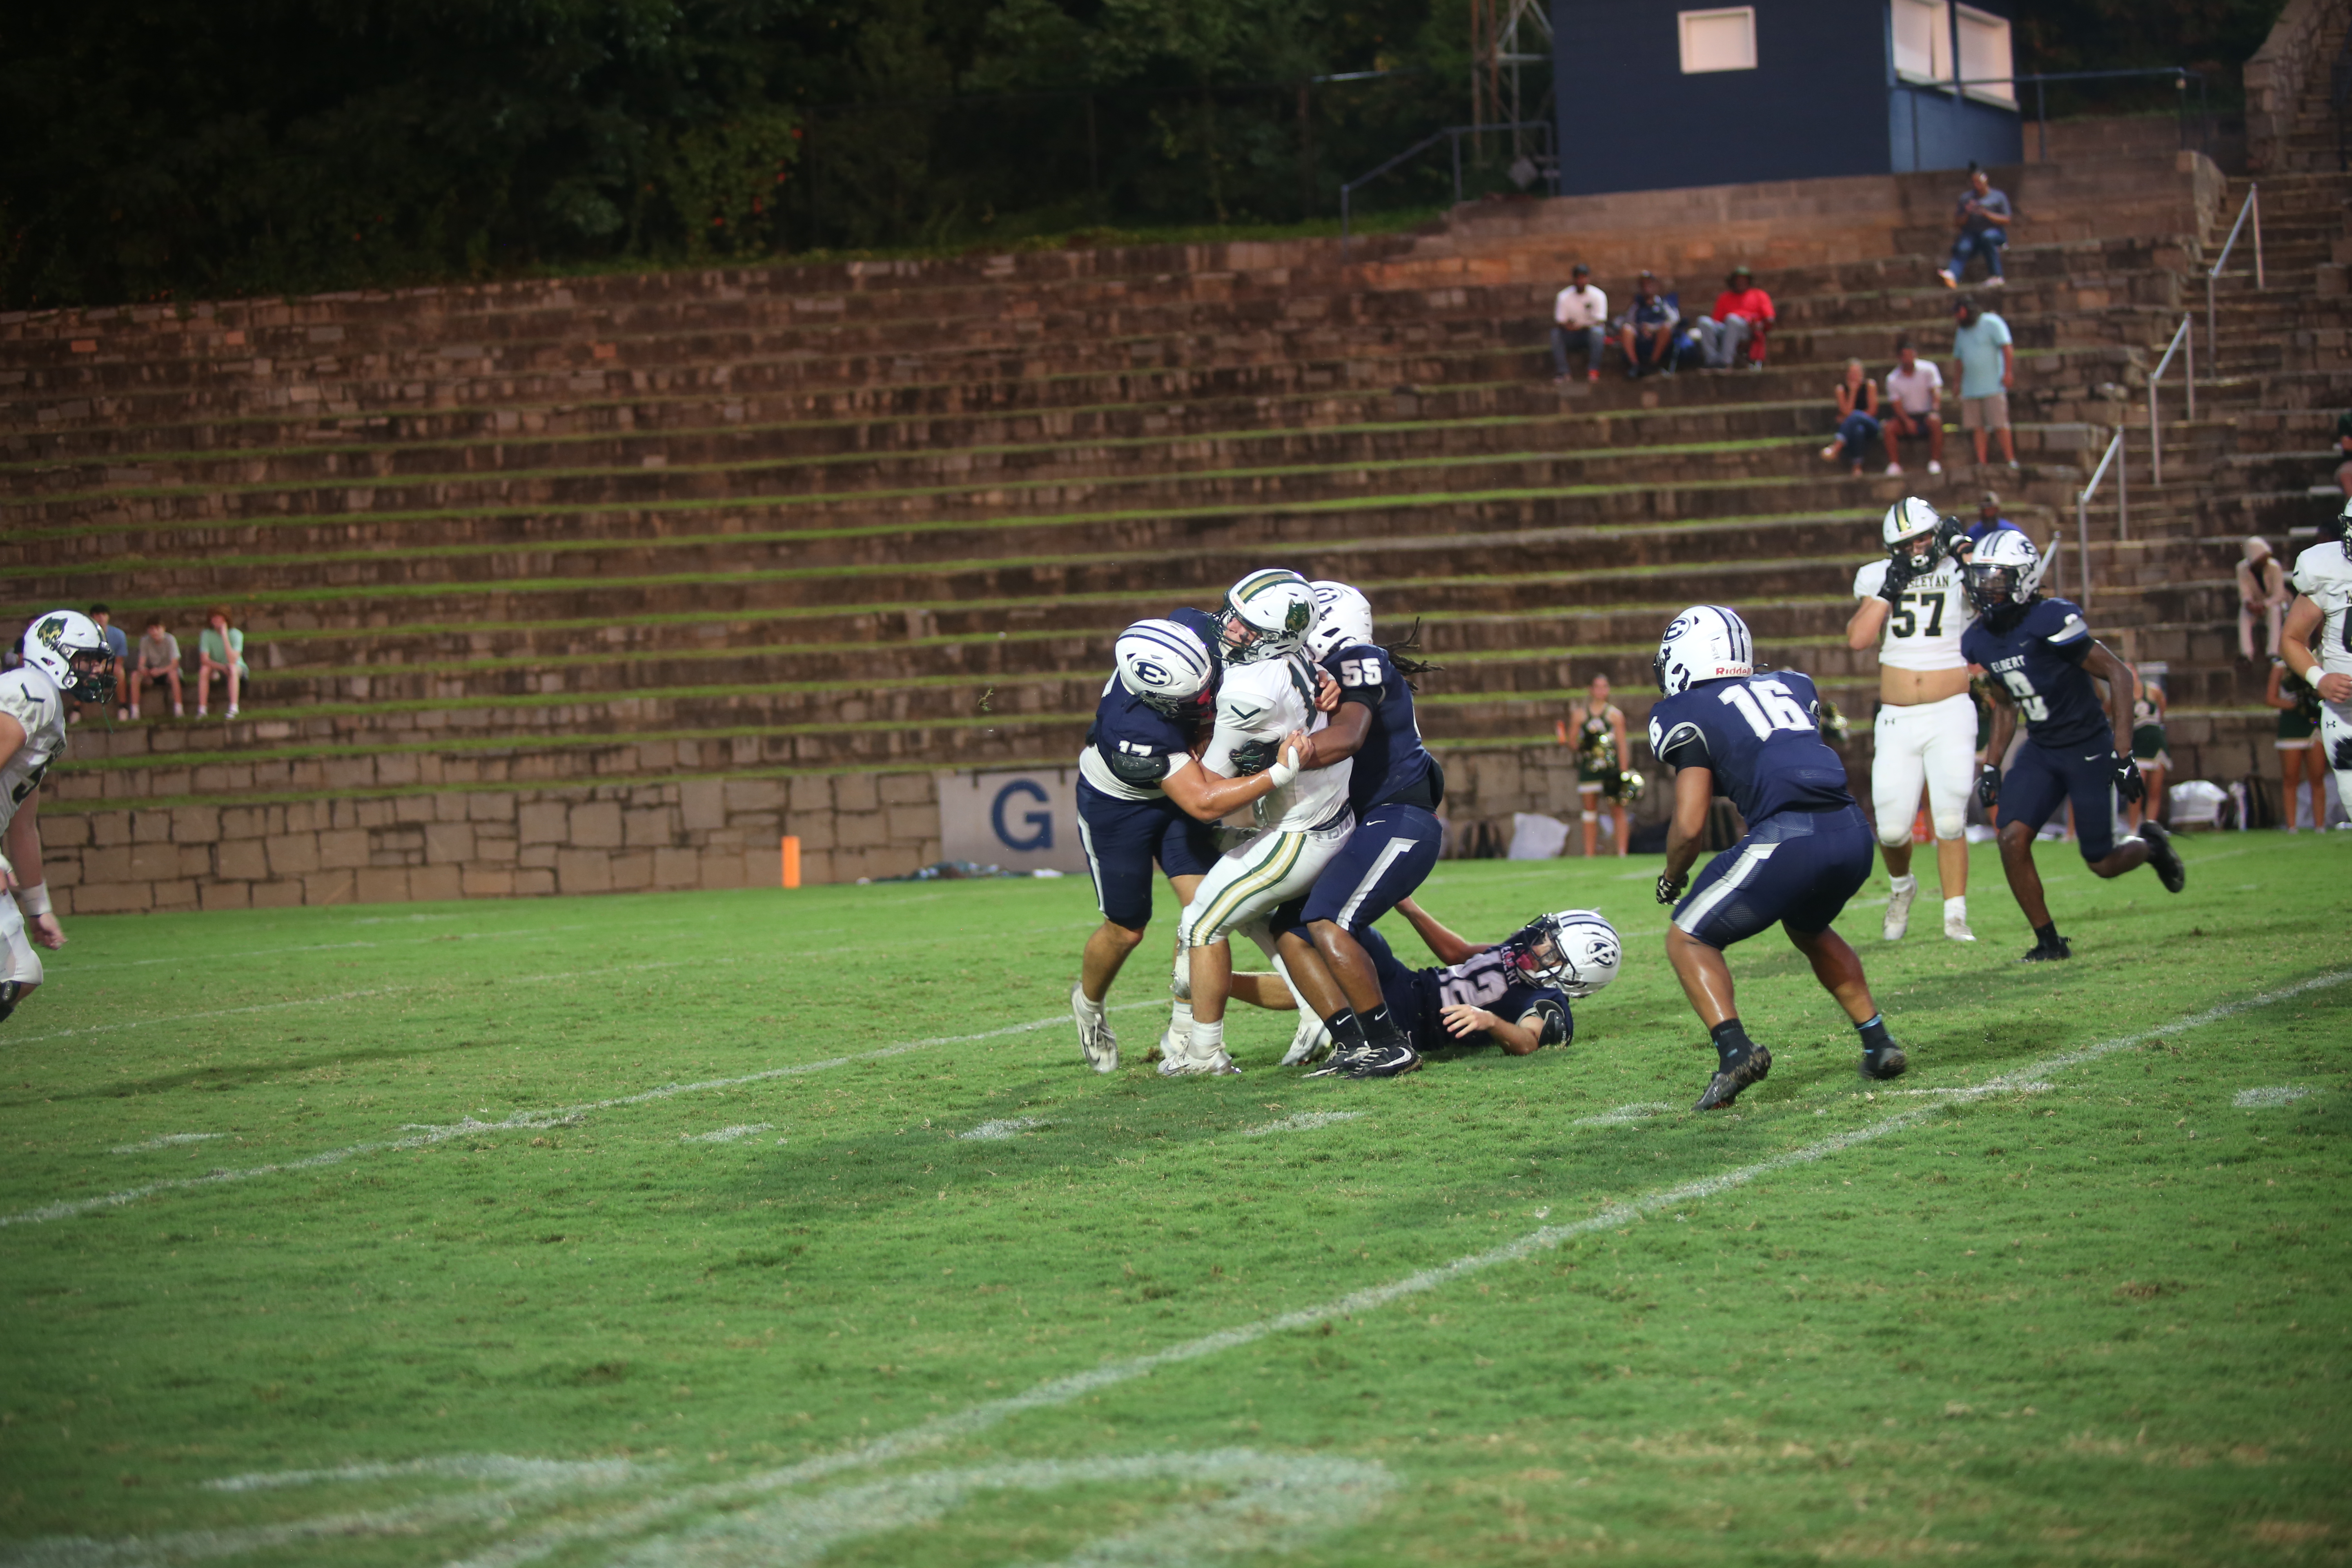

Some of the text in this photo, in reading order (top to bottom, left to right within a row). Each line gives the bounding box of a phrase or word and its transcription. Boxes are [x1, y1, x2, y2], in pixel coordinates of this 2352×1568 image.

[1907, 575, 1949, 588] SLEYAN
[1892, 592, 1944, 638] 57
[1664, 619, 1686, 641] E
[1135, 662, 1167, 685] E
[1341, 657, 1383, 687] 55
[1716, 667, 1751, 675] Riddell
[1990, 655, 2025, 673] ELBERT
[1718, 679, 1815, 742] 16
[991, 778, 1054, 851] G
